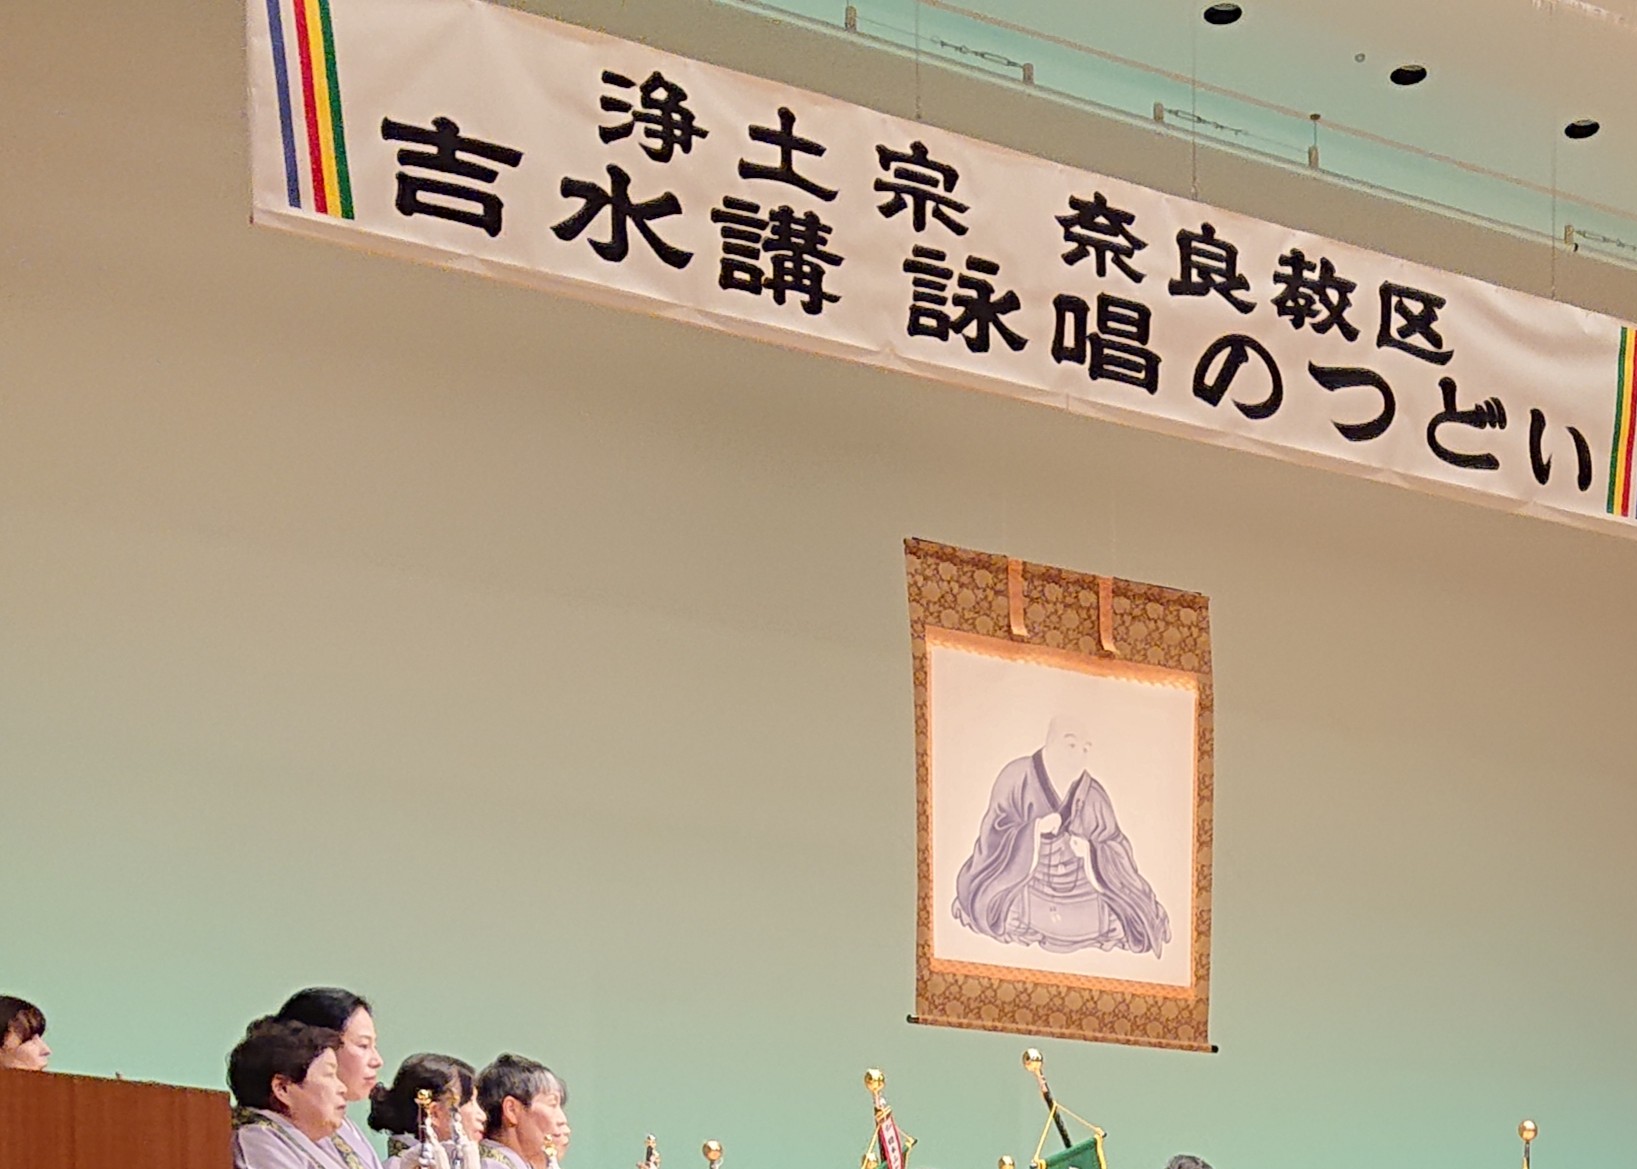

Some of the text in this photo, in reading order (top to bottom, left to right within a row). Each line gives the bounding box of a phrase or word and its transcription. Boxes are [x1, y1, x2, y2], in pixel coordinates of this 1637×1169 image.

[380, 115, 1595, 493] 吉水講 詠唱のつどい
[597, 70, 1456, 367] 浄土宗 奈良教区
